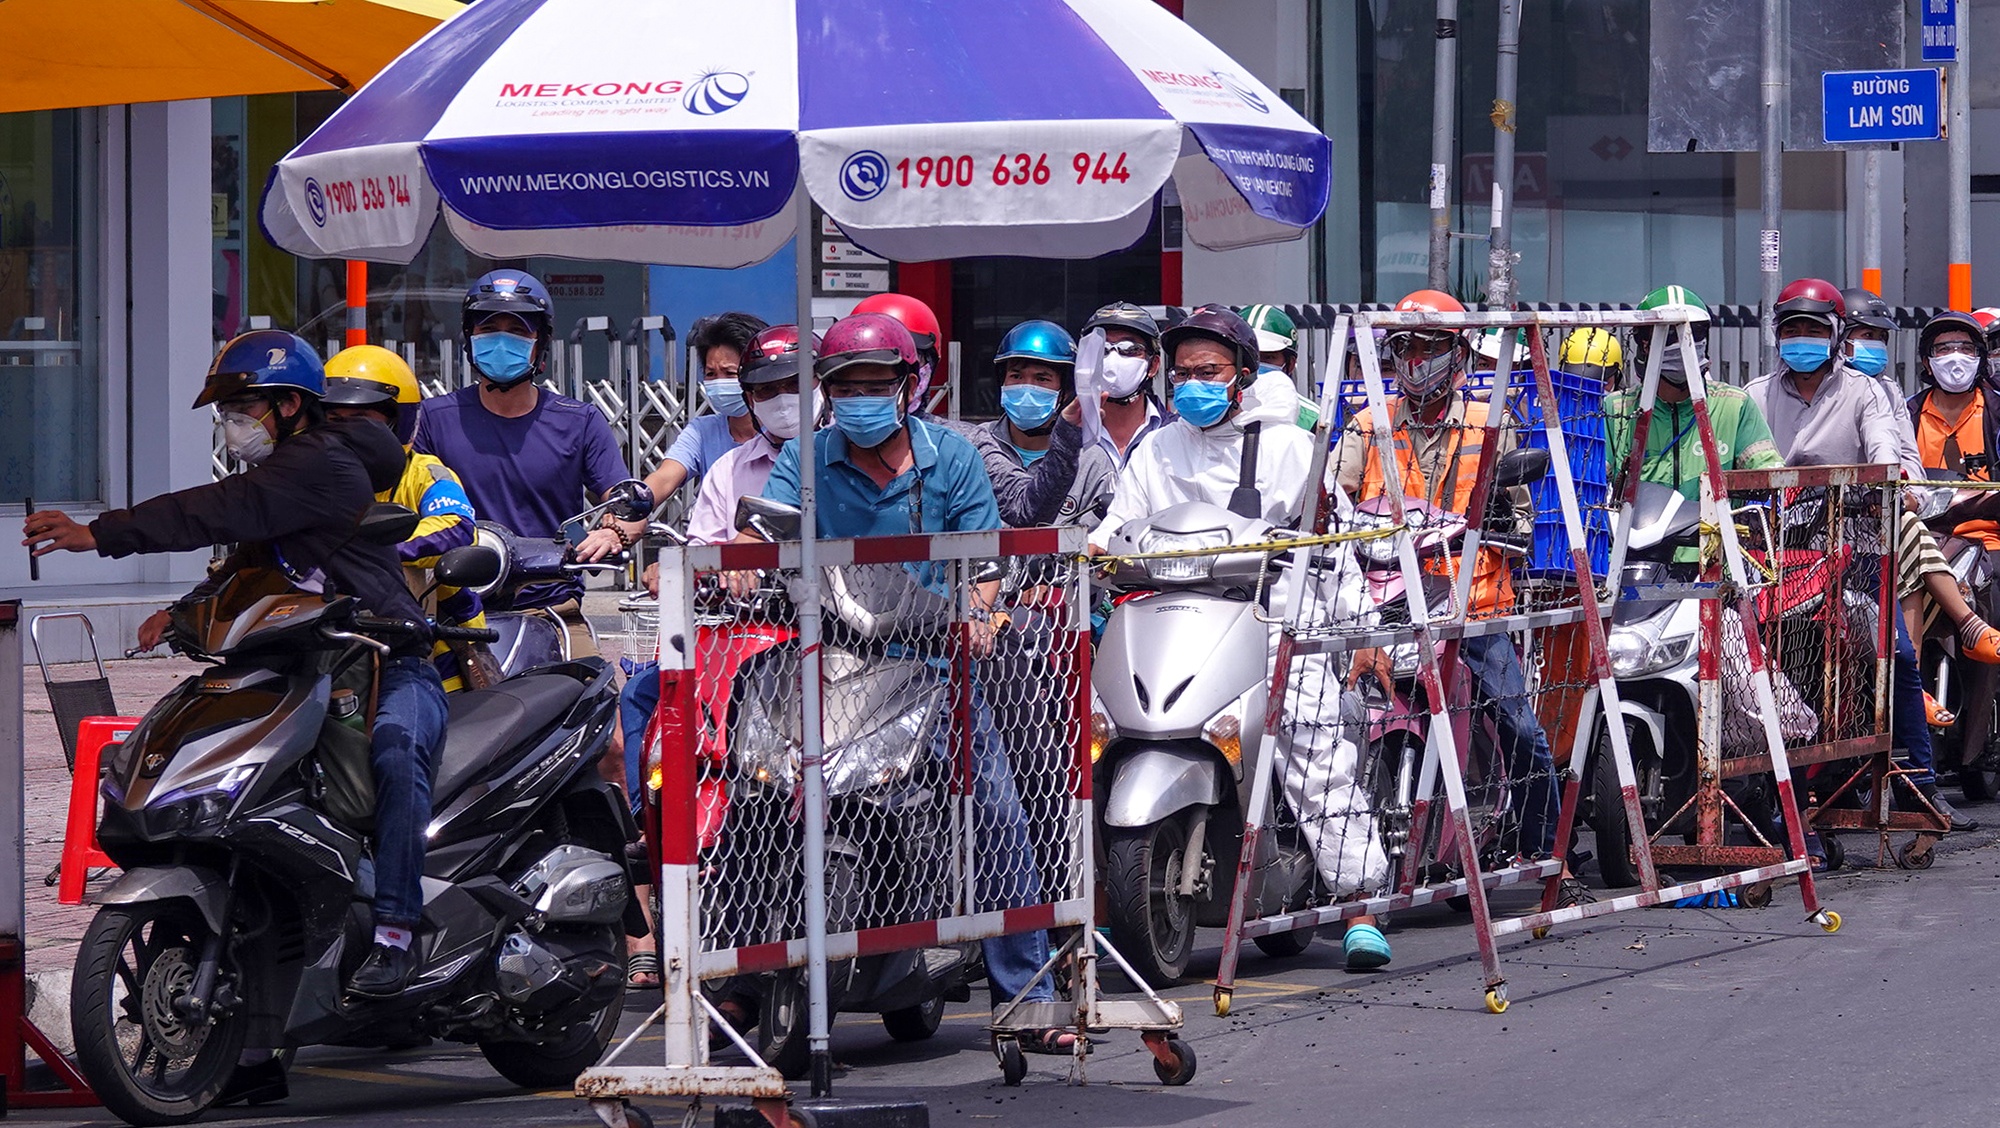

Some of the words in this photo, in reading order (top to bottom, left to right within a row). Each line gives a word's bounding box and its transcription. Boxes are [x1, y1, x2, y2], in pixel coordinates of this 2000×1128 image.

[499, 80, 684, 98] MEKONG
[1141, 69, 1222, 90] MEKONG
[1852, 75, 1910, 96] ĐƯỜNG
[495, 99, 558, 108] LOGISTICS
[560, 98, 621, 107] COMPANY
[624, 97, 676, 105] LIMITED
[1849, 105, 1884, 128] LAM
[1891, 104, 1924, 127] SƠN
[896, 155, 974, 189] 1900
[992, 152, 1051, 186] 636
[1072, 151, 1131, 184] 944
[460, 170, 770, 195] WWW.MEKONGLOGISTICS.VN
[325, 180, 358, 215] 1900
[361, 177, 385, 211] 636
[388, 174, 411, 208] 944
[1692, 440, 1729, 456] Gb
[278, 821, 319, 845] 125
